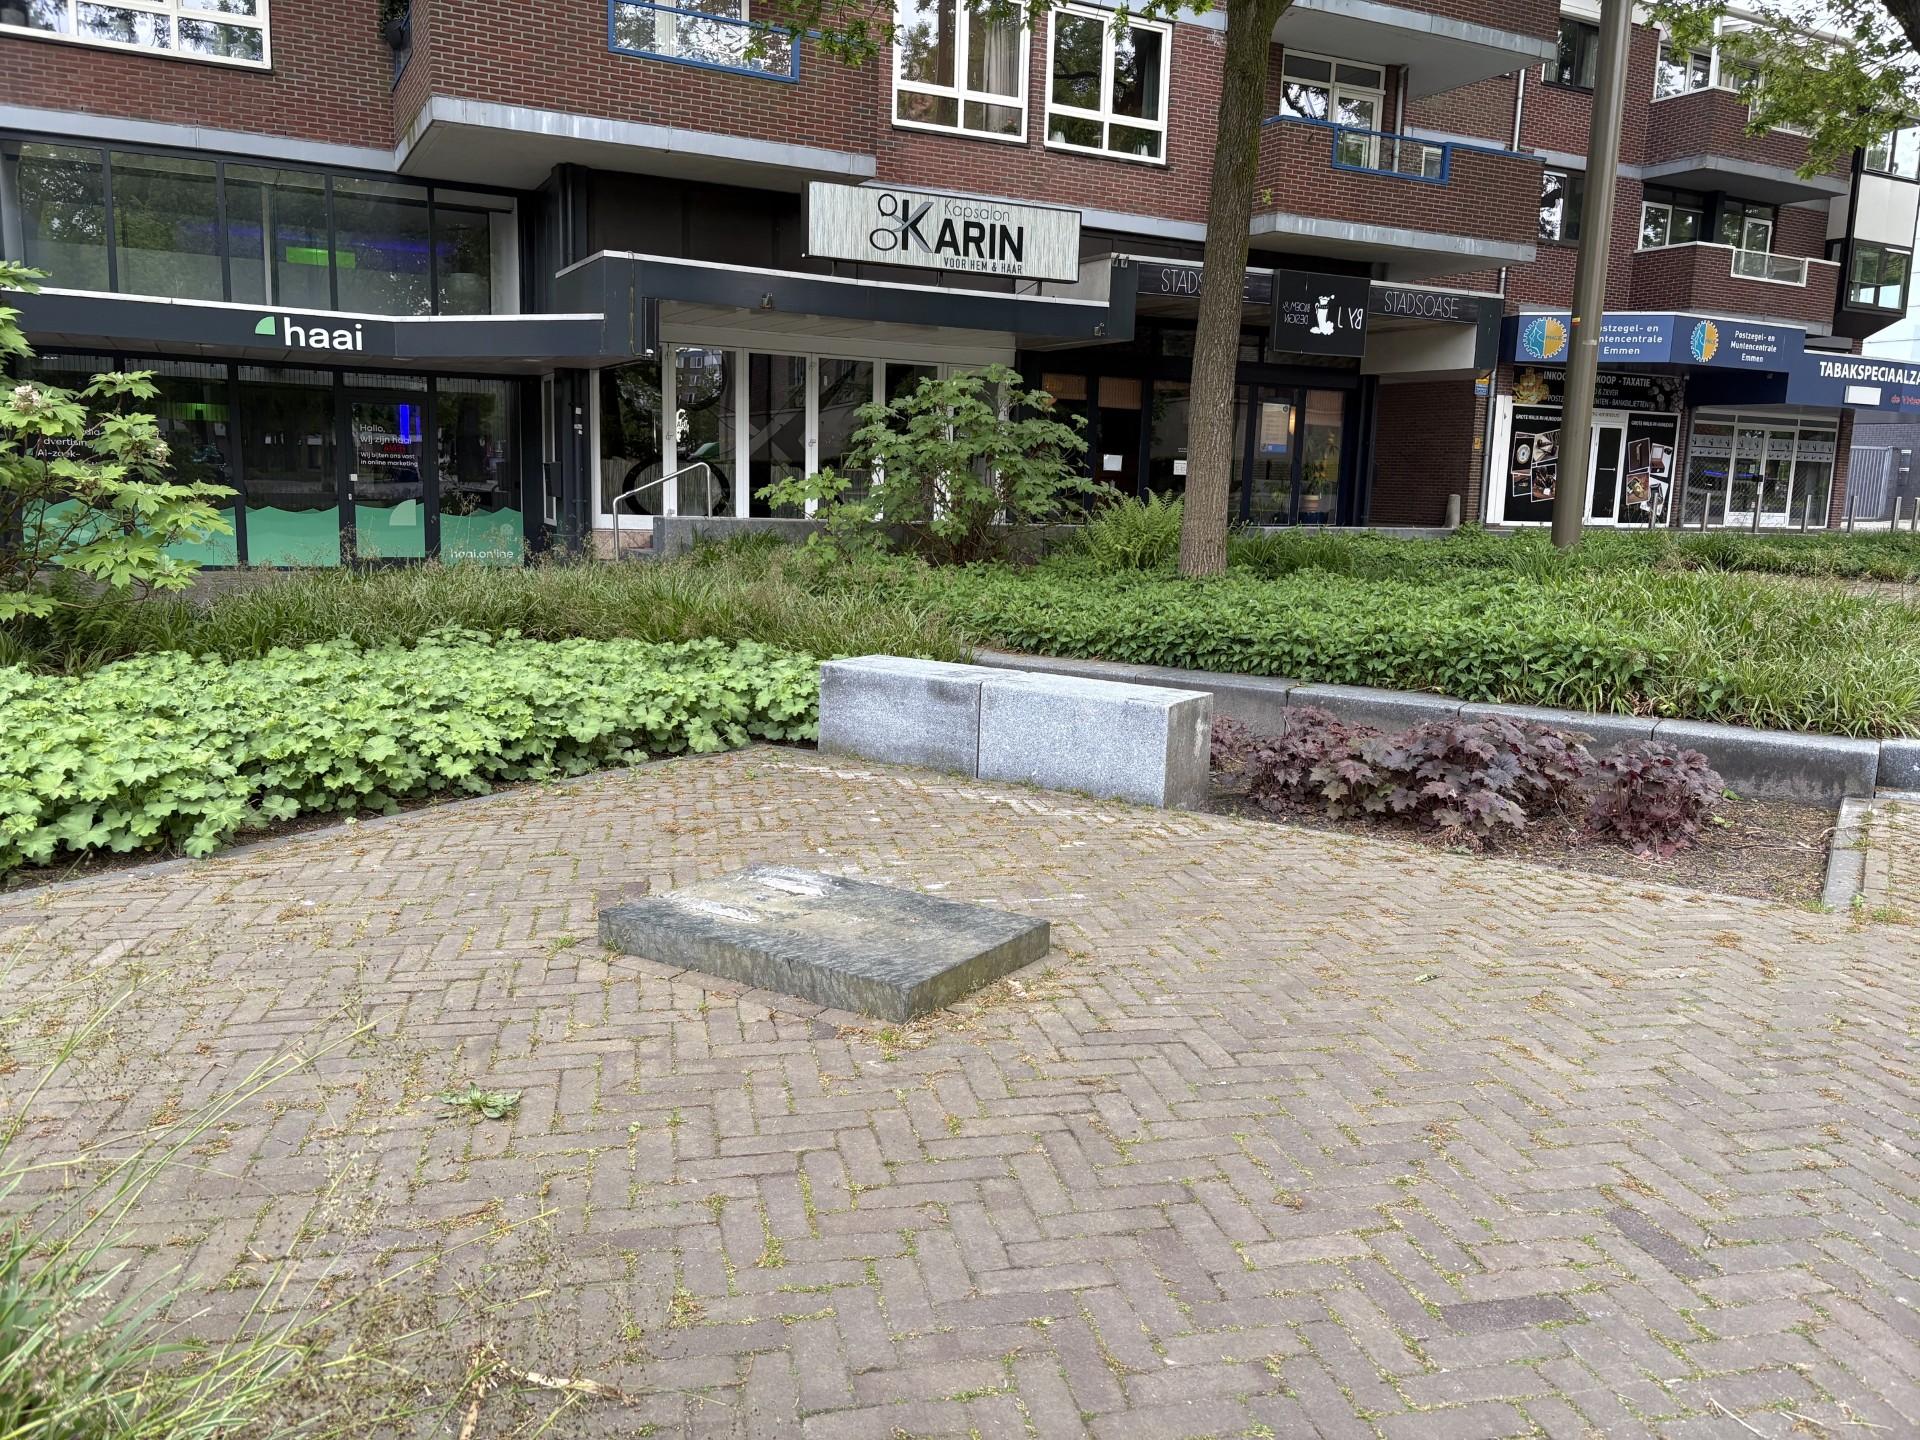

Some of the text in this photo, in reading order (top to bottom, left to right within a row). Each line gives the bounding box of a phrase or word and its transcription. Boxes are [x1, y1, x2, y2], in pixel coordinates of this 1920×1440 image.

[944, 199, 1010, 222] Kapsalon
[901, 199, 1024, 263] KARIN
[943, 257, 1023, 274] VOOR HEM & HAAR
[1384, 290, 1460, 319] STADSOASE
[283, 316, 363, 351] haai
[1600, 324, 1659, 334] stzegel- en
[1598, 334, 1663, 343] ntencentrale
[1735, 330, 1767, 342] Postzegel-
[1603, 346, 1640, 355] Emmen
[1730, 340, 1777, 353] Muntencentrale
[1741, 353, 1764, 363] Emmen
[1543, 371, 1651, 388] INKO KOOP TAXATIE
[360, 424, 386, 433] Hallo,
[43, 437, 95, 449] dvertising
[387, 460, 419, 468] marketing
